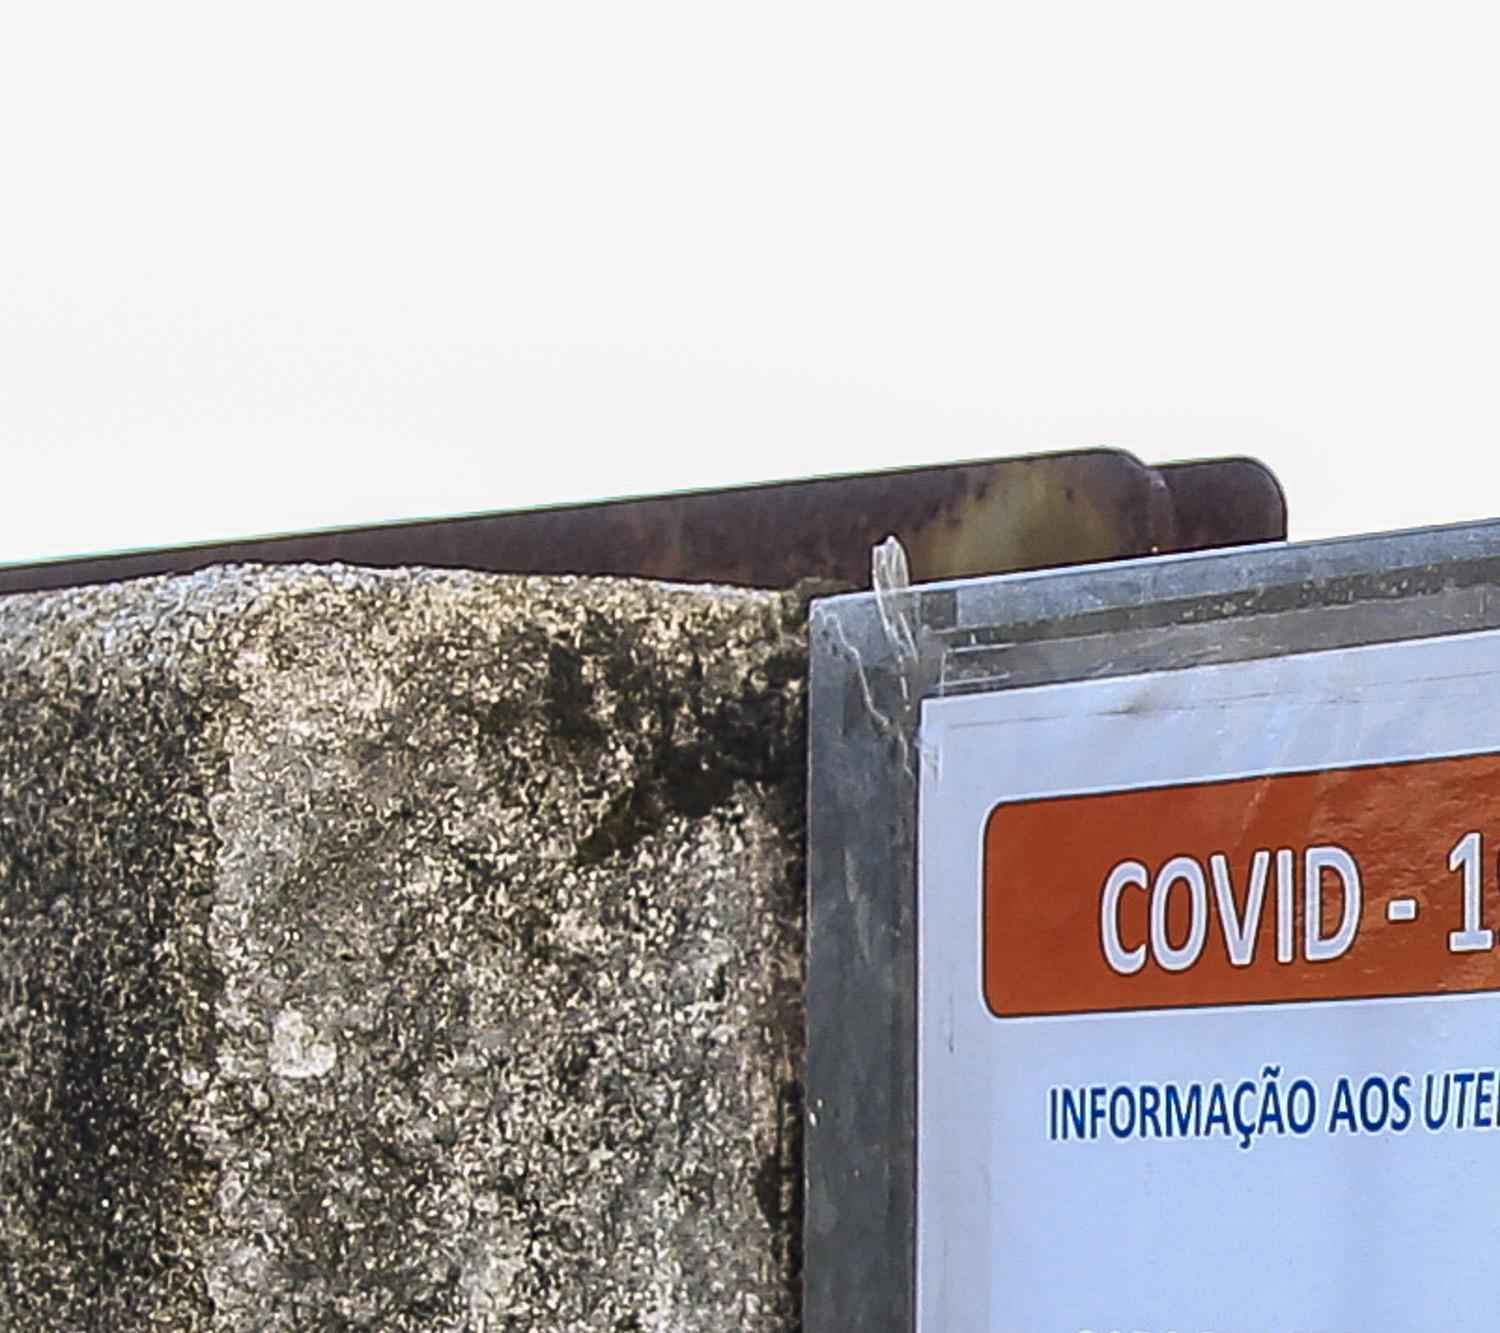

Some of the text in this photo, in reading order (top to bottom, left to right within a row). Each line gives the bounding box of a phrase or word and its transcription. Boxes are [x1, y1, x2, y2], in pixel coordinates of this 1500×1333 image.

[1101, 847, 1361, 975] COVID
[1387, 897, 1417, 920] -
[1050, 1066, 1316, 1148] INFORMAÇÃO
[1329, 1077, 1411, 1133] AOS
